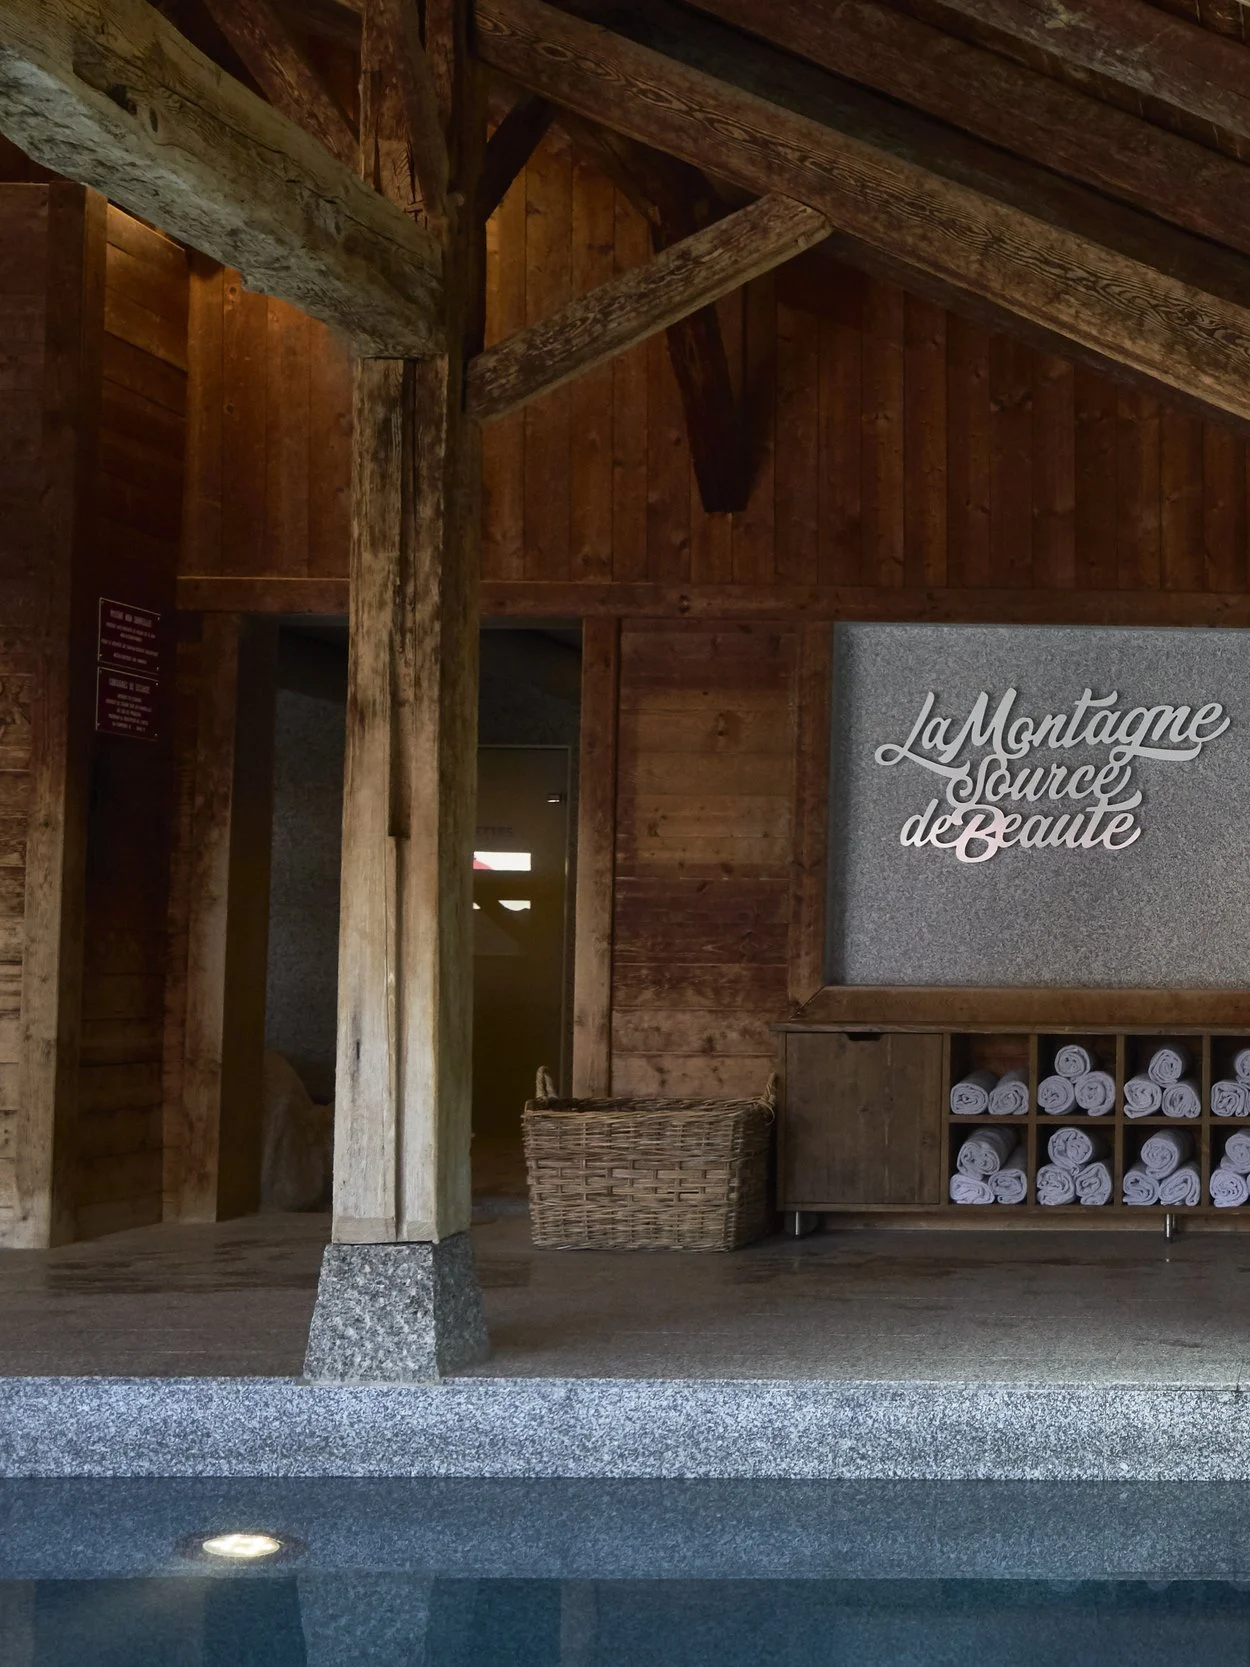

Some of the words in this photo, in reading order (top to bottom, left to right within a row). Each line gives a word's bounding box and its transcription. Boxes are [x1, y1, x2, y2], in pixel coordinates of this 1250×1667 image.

[874, 691, 971, 778] La
[937, 687, 1231, 768] Montagne
[946, 752, 1132, 808] Source
[900, 798, 957, 848] de
